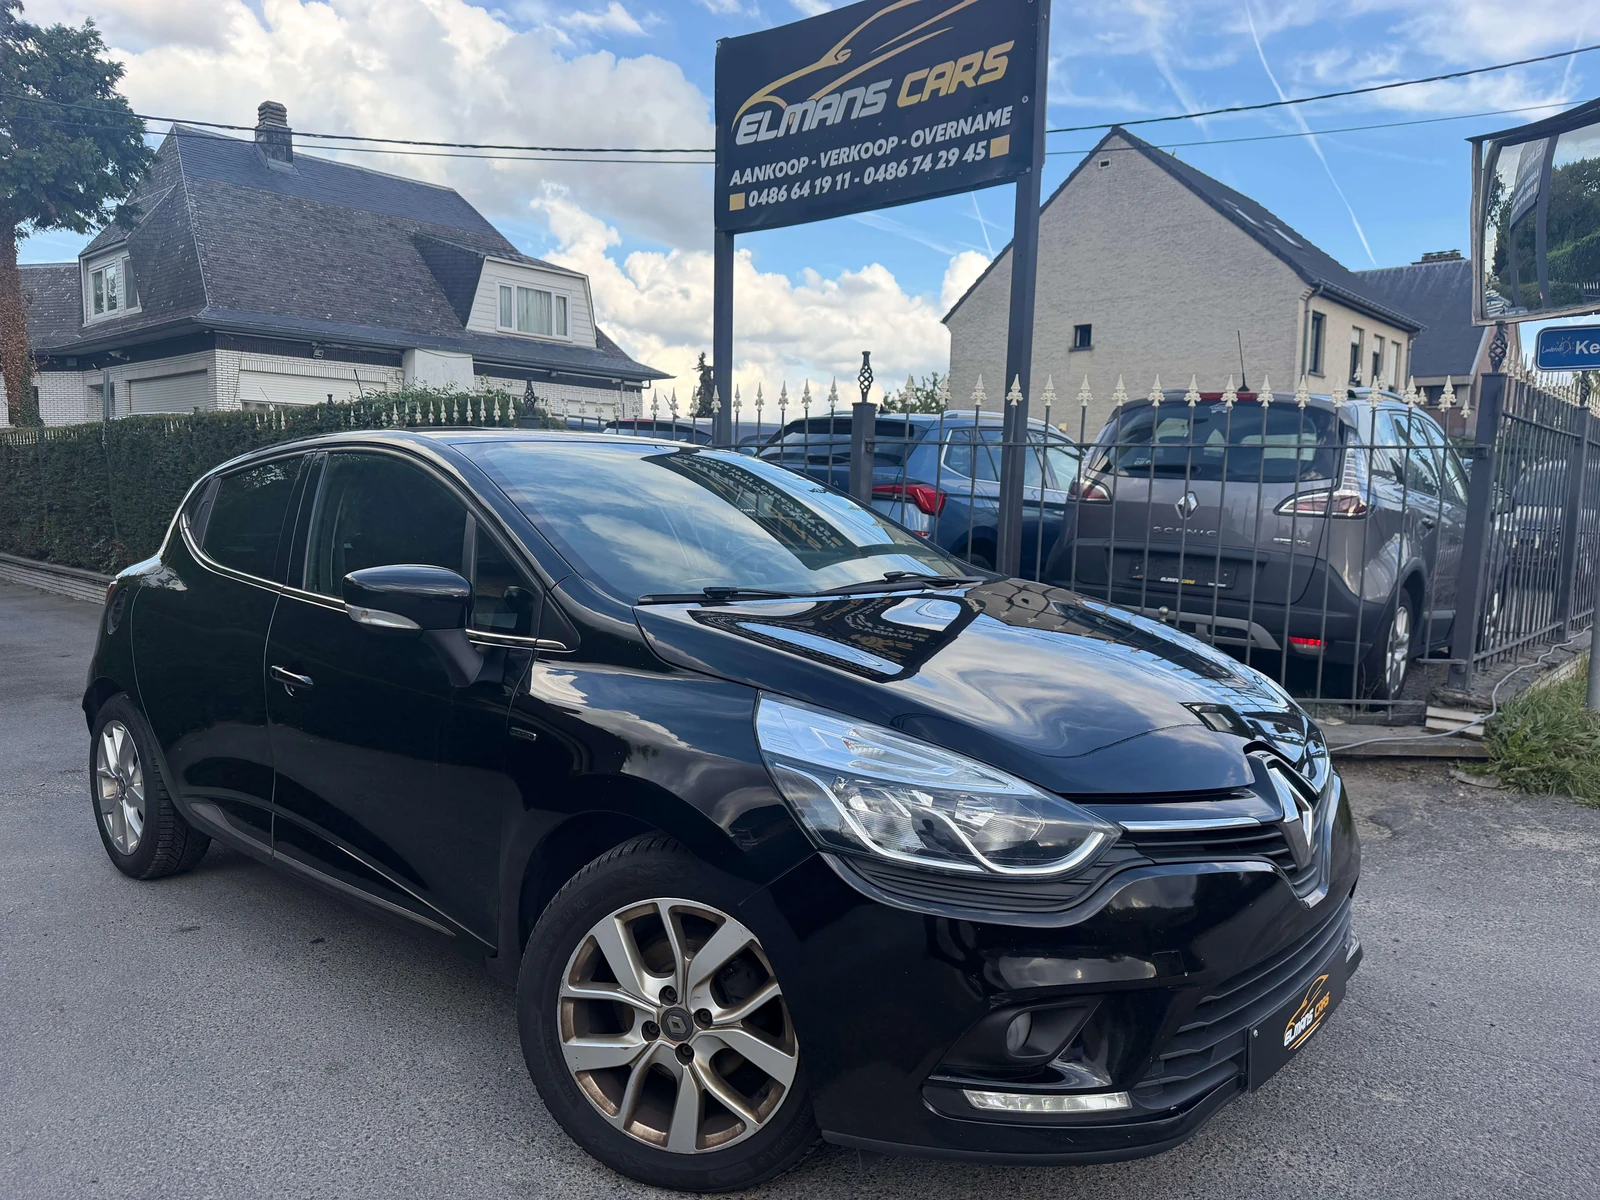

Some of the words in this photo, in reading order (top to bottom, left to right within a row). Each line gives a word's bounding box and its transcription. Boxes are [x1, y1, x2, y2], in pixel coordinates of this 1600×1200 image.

[735, 79, 892, 145] ELMANS
[897, 40, 1015, 107] CARS
[729, 156, 809, 186] AANKOOP
[820, 136, 898, 168] VERKOOP
[910, 105, 1013, 148] OVERNAME
[748, 184, 788, 207] 0486
[791, 180, 811, 200] 64
[814, 175, 832, 195] 19
[835, 171, 851, 191] 11
[863, 158, 908, 185] 0486
[911, 153, 933, 175] 74
[934, 147, 960, 170] 29
[962, 140, 987, 163] 45
